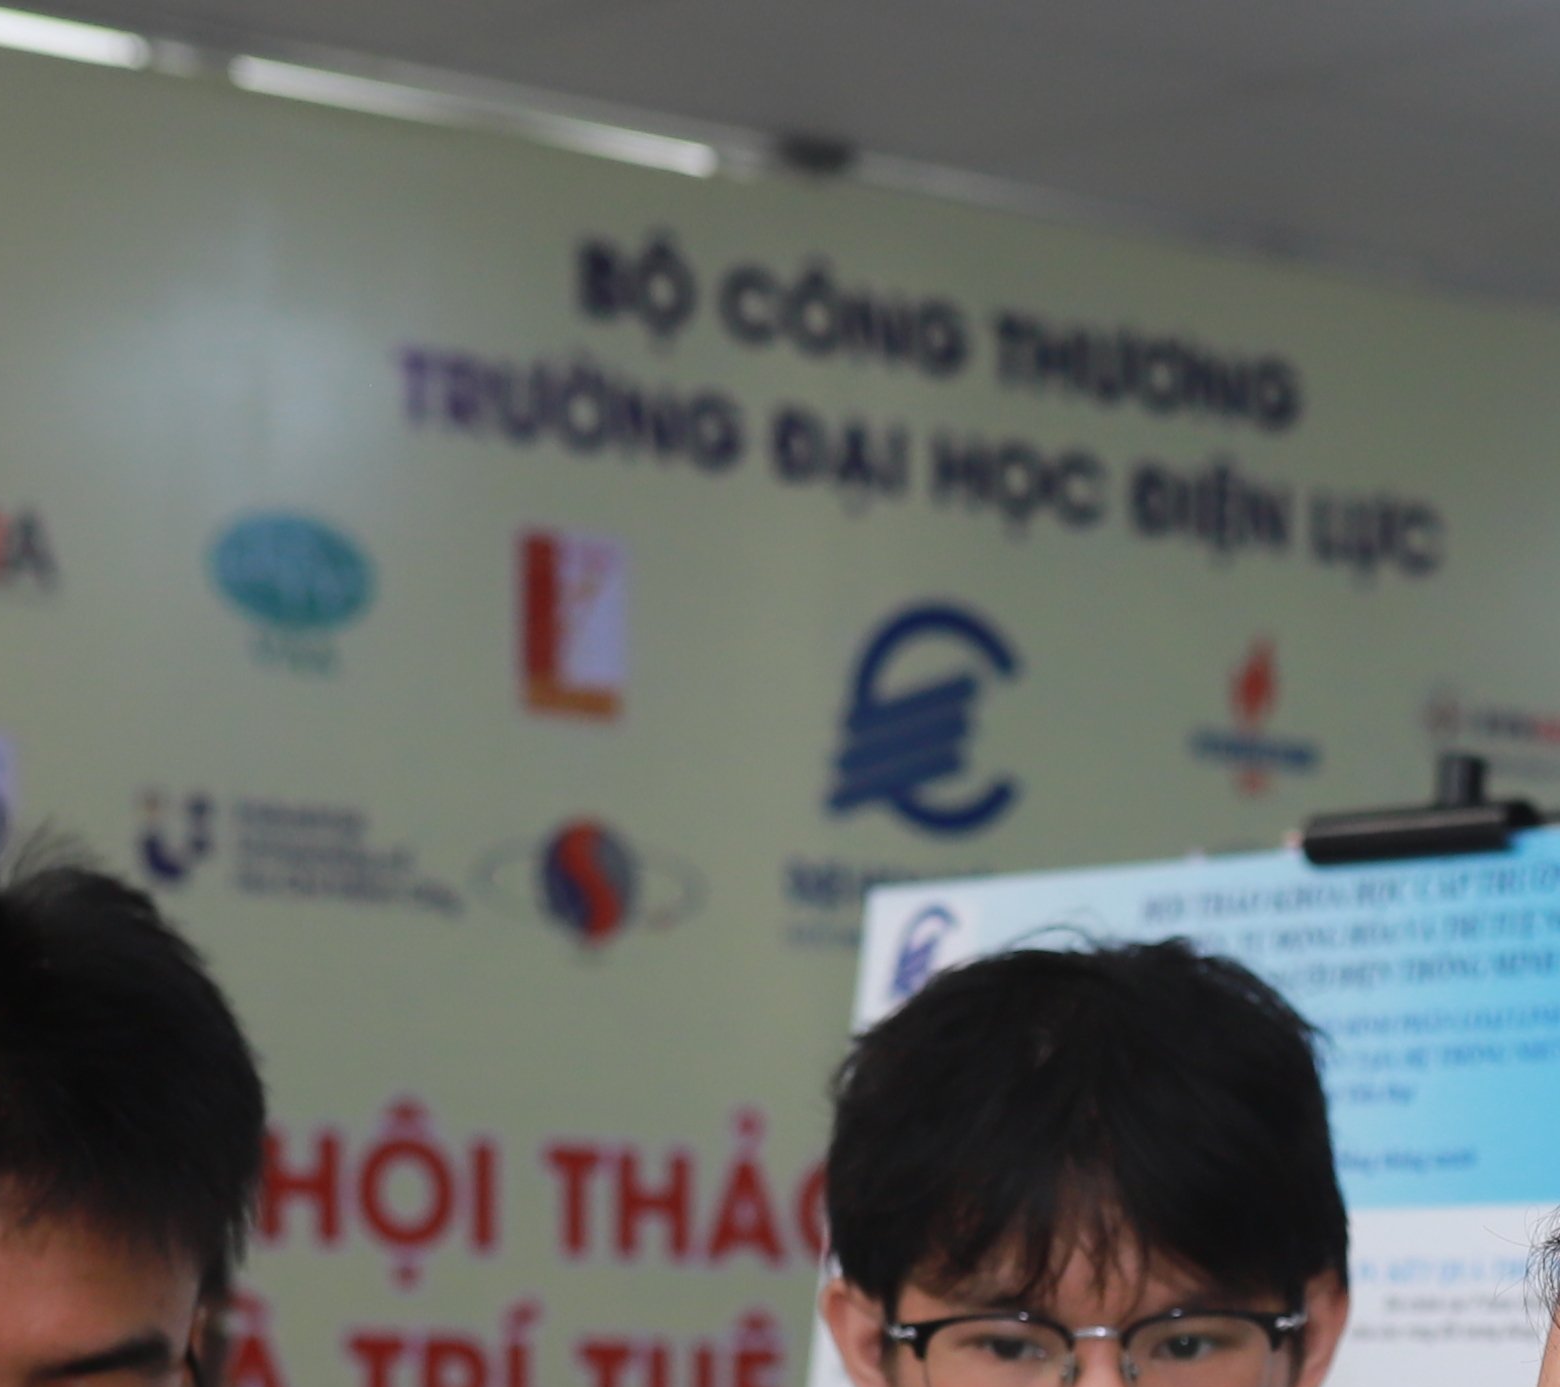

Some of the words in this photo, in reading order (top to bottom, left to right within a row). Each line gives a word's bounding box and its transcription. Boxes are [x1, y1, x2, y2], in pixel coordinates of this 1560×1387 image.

[578, 230, 694, 350] BỘ
[716, 252, 968, 378] CÔNG
[993, 310, 1301, 434] THƯƠNG
[396, 345, 742, 471] TRƯỜNG
[769, 405, 908, 517] ĐẠI
[928, 430, 1108, 540] HỌC
[1127, 452, 1293, 567] ĐIỆN
[1309, 488, 1445, 586] LỰC
[255, 1100, 498, 1291] HỘI
